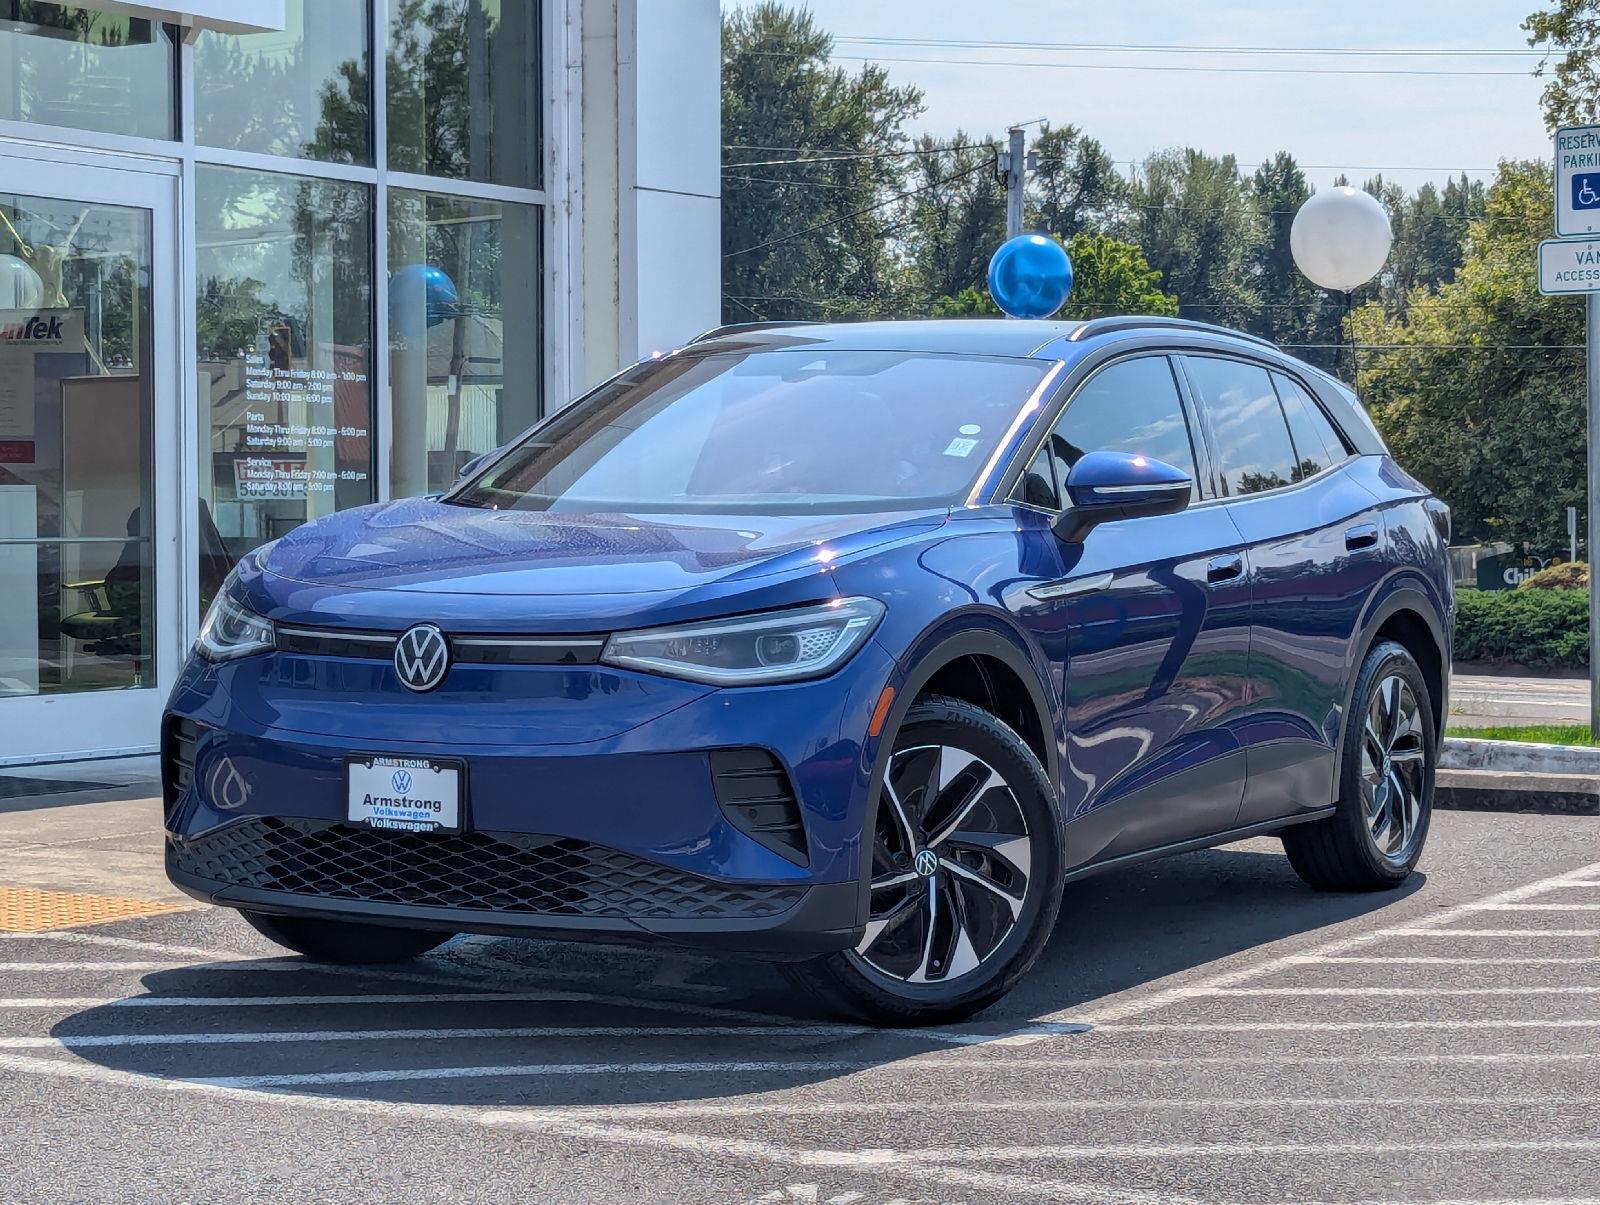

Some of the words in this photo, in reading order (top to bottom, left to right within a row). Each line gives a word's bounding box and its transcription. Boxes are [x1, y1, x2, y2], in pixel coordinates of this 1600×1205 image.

[1563, 153, 1600, 168] PARKI
[1555, 269, 1600, 282] ACCESS
[246, 354, 264, 364] Sales
[246, 366, 273, 378] Monday
[273, 368, 290, 377] Thru
[290, 369, 311, 380] Friday
[355, 374, 367, 383] pm
[246, 379, 276, 390] Saturday
[246, 390, 272, 402] Sunday
[272, 392, 291, 401] 10:00
[246, 411, 264, 421] Parts
[246, 424, 274, 436] Monday
[274, 425, 290, 434] Thru
[290, 425, 311, 437] Friday
[355, 429, 367, 438] pm
[246, 436, 277, 447] Saturday
[277, 437, 292, 446] 9:00
[246, 456, 272, 467] Service
[246, 469, 274, 480] Monday
[274, 470, 290, 479] Thru
[291, 470, 312, 481] Friday
[341, 470, 356, 480] 6:00
[355, 473, 367, 482] pm
[246, 481, 277, 492] Saturday
[397, 627, 446, 688] VW
[373, 757, 430, 769] ARMSTRONG
[392, 769, 412, 794] VW
[362, 793, 442, 813] Armstrong
[373, 806, 431, 819] Volkswagen
[369, 817, 434, 833] Volkswagen
